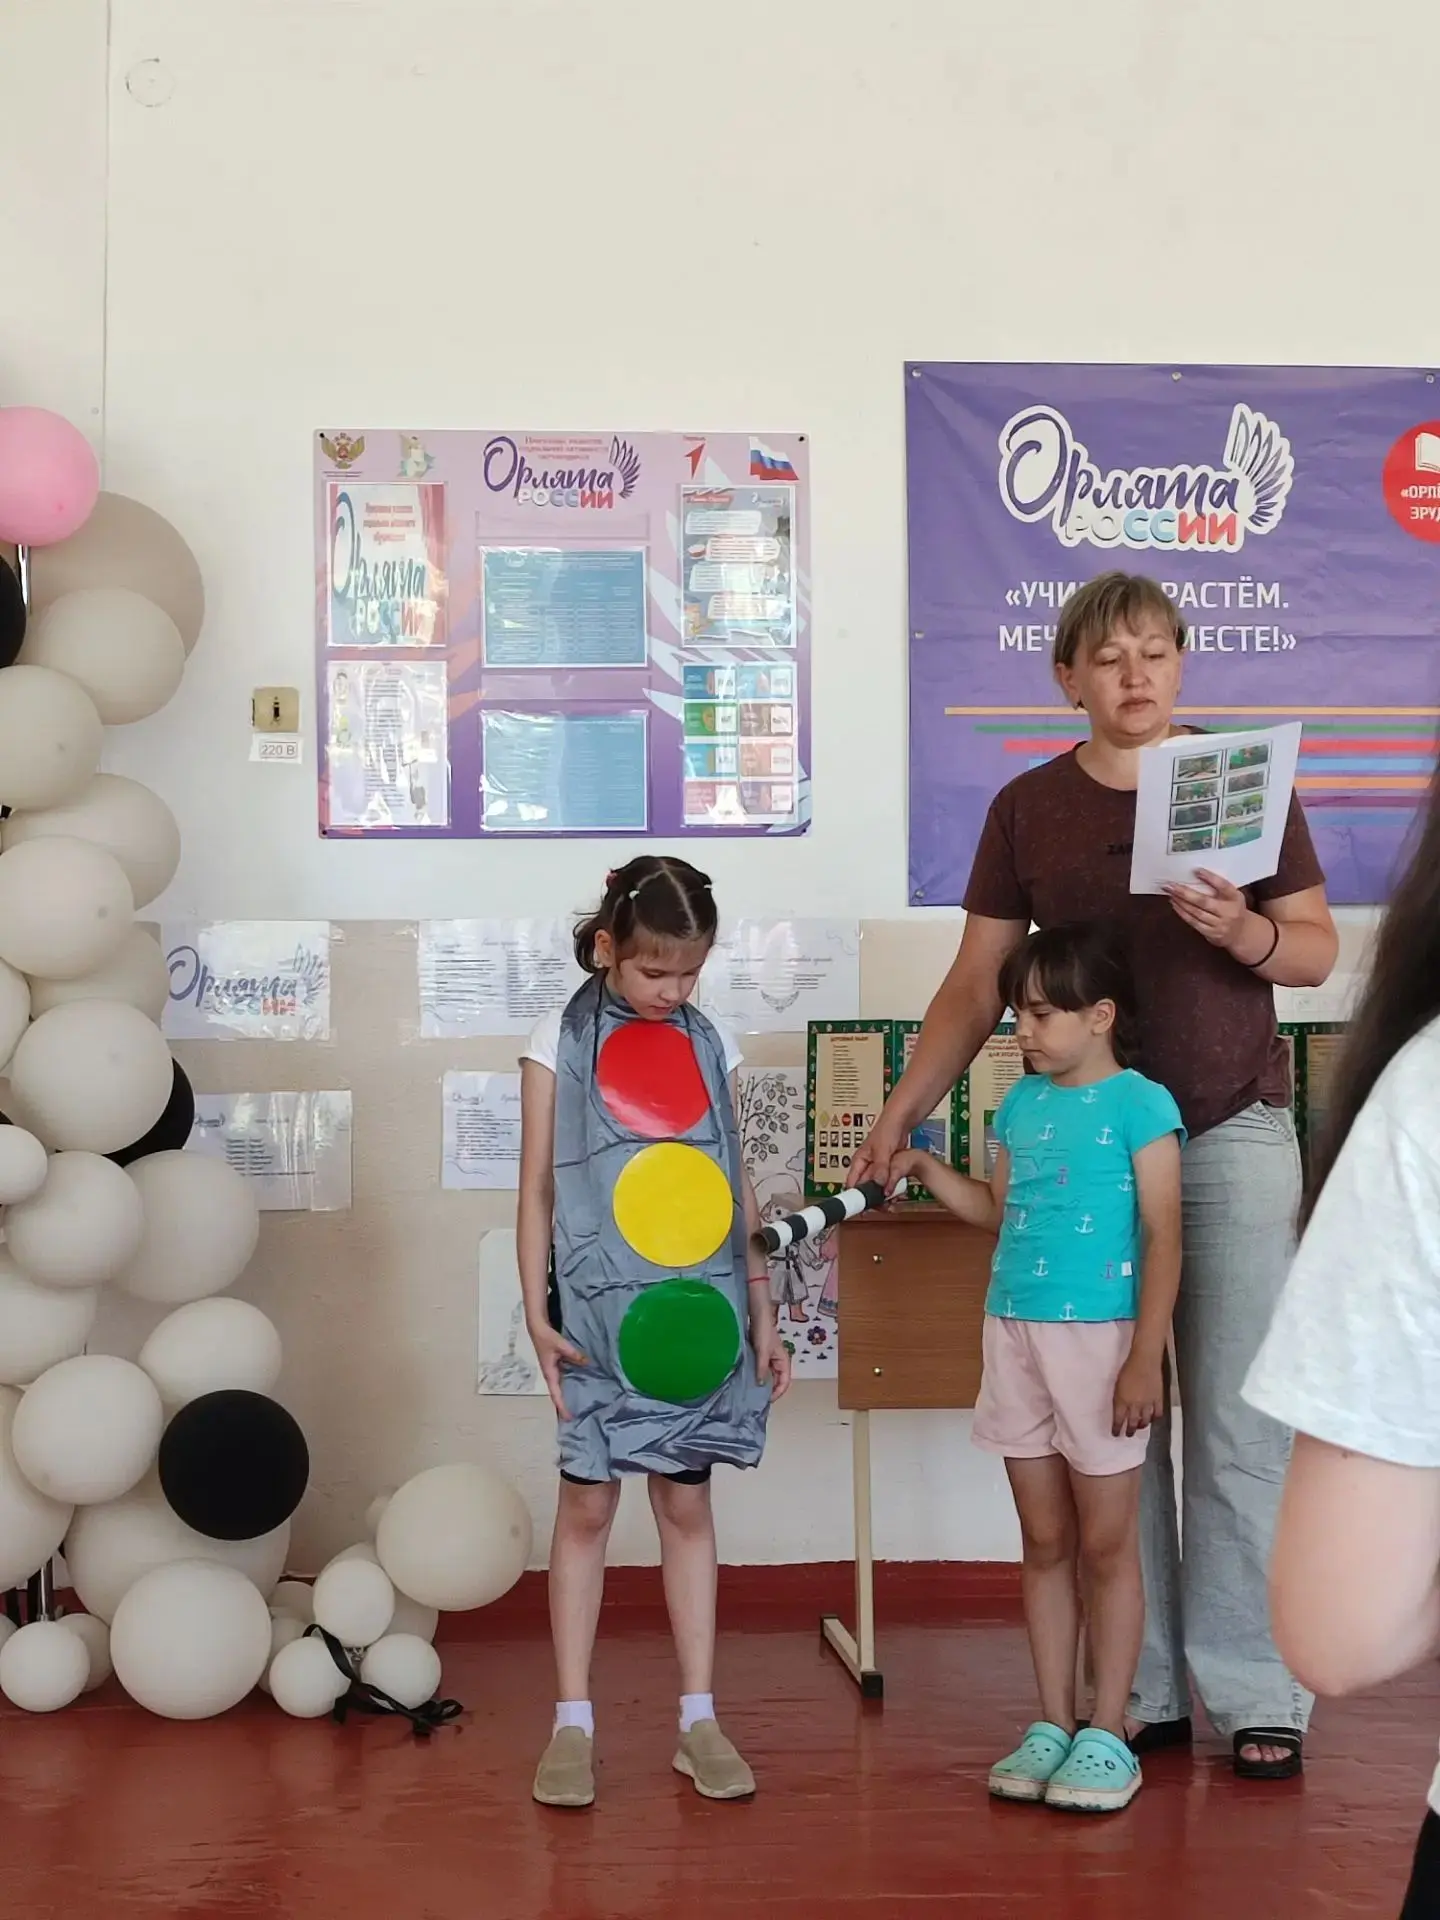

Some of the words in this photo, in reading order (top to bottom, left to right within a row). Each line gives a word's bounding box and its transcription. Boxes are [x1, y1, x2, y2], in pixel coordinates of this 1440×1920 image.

[483, 435, 615, 499] Орлята
[1005, 412, 1240, 528] Орлята
[516, 487, 614, 509] РОССИИ
[1400, 482, 1440, 500] «ОРЛ
[1065, 508, 1238, 546] РОССИИ
[1161, 576, 1289, 609] РАСТЁМ.
[1183, 625, 1297, 652] МЕСТЕ!»
[261, 744, 283, 756] 220
